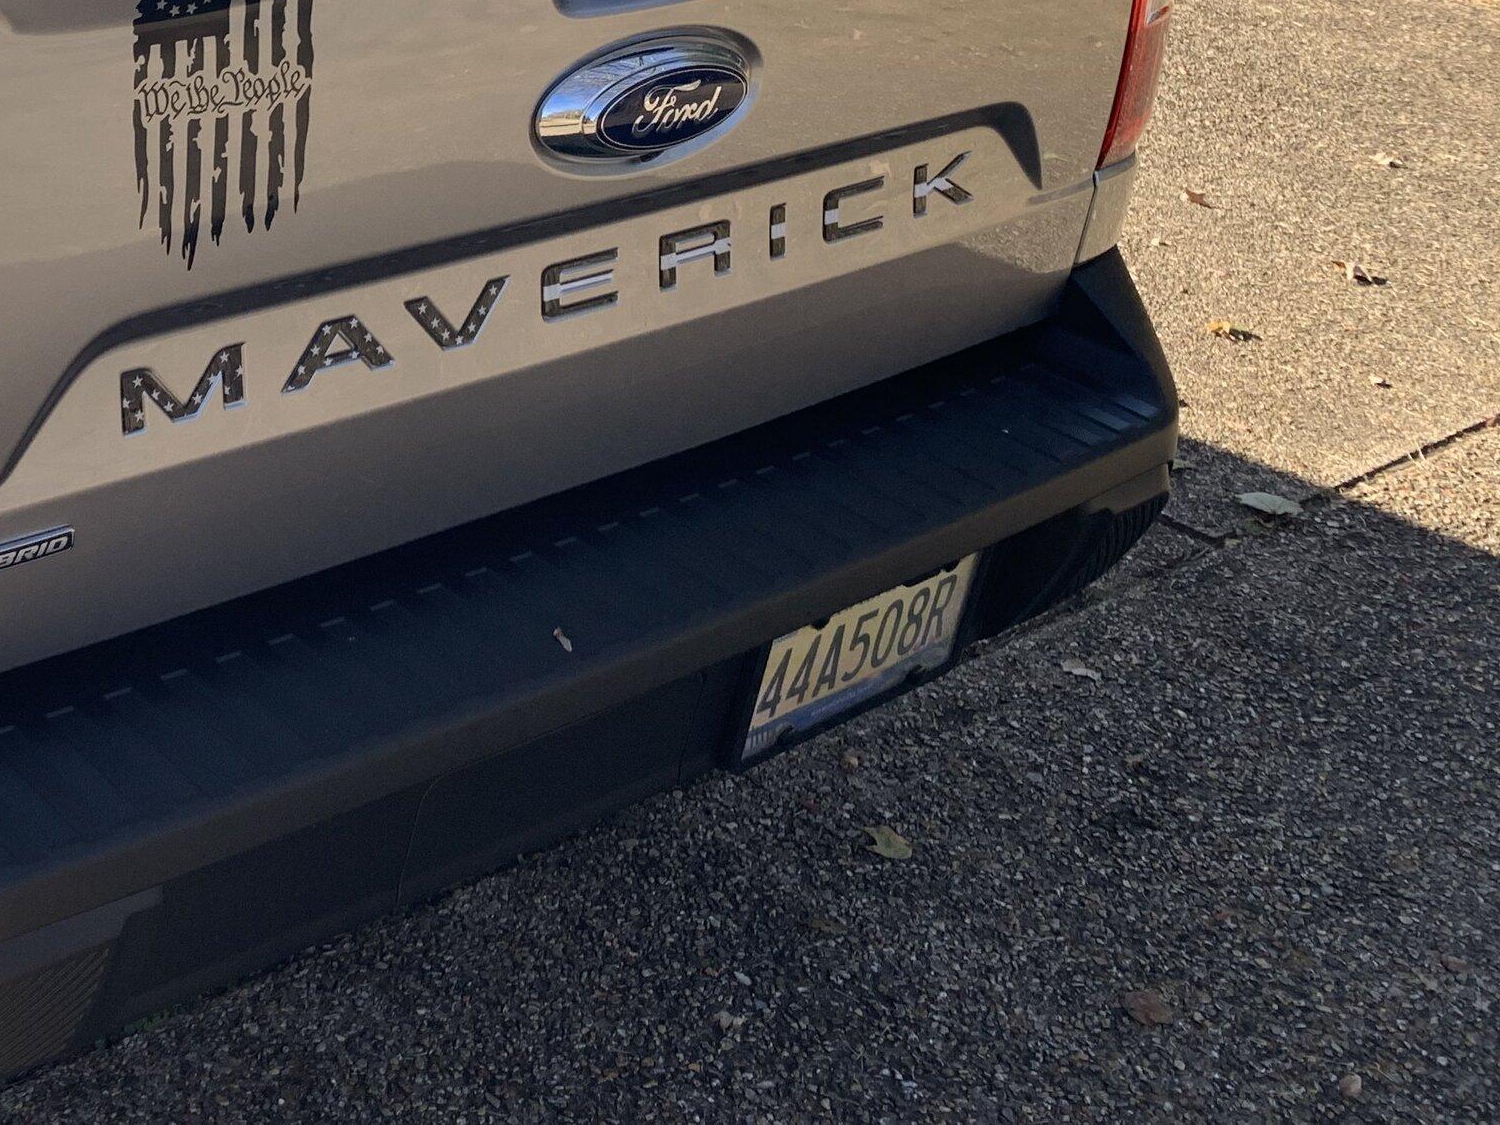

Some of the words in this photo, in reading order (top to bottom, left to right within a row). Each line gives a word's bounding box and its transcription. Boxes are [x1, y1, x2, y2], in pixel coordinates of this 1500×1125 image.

[138, 81, 187, 123] We
[218, 61, 306, 114] People
[632, 79, 722, 133] Ford
[119, 150, 974, 437] MAVERICK
[756, 574, 958, 719] 44A508R
